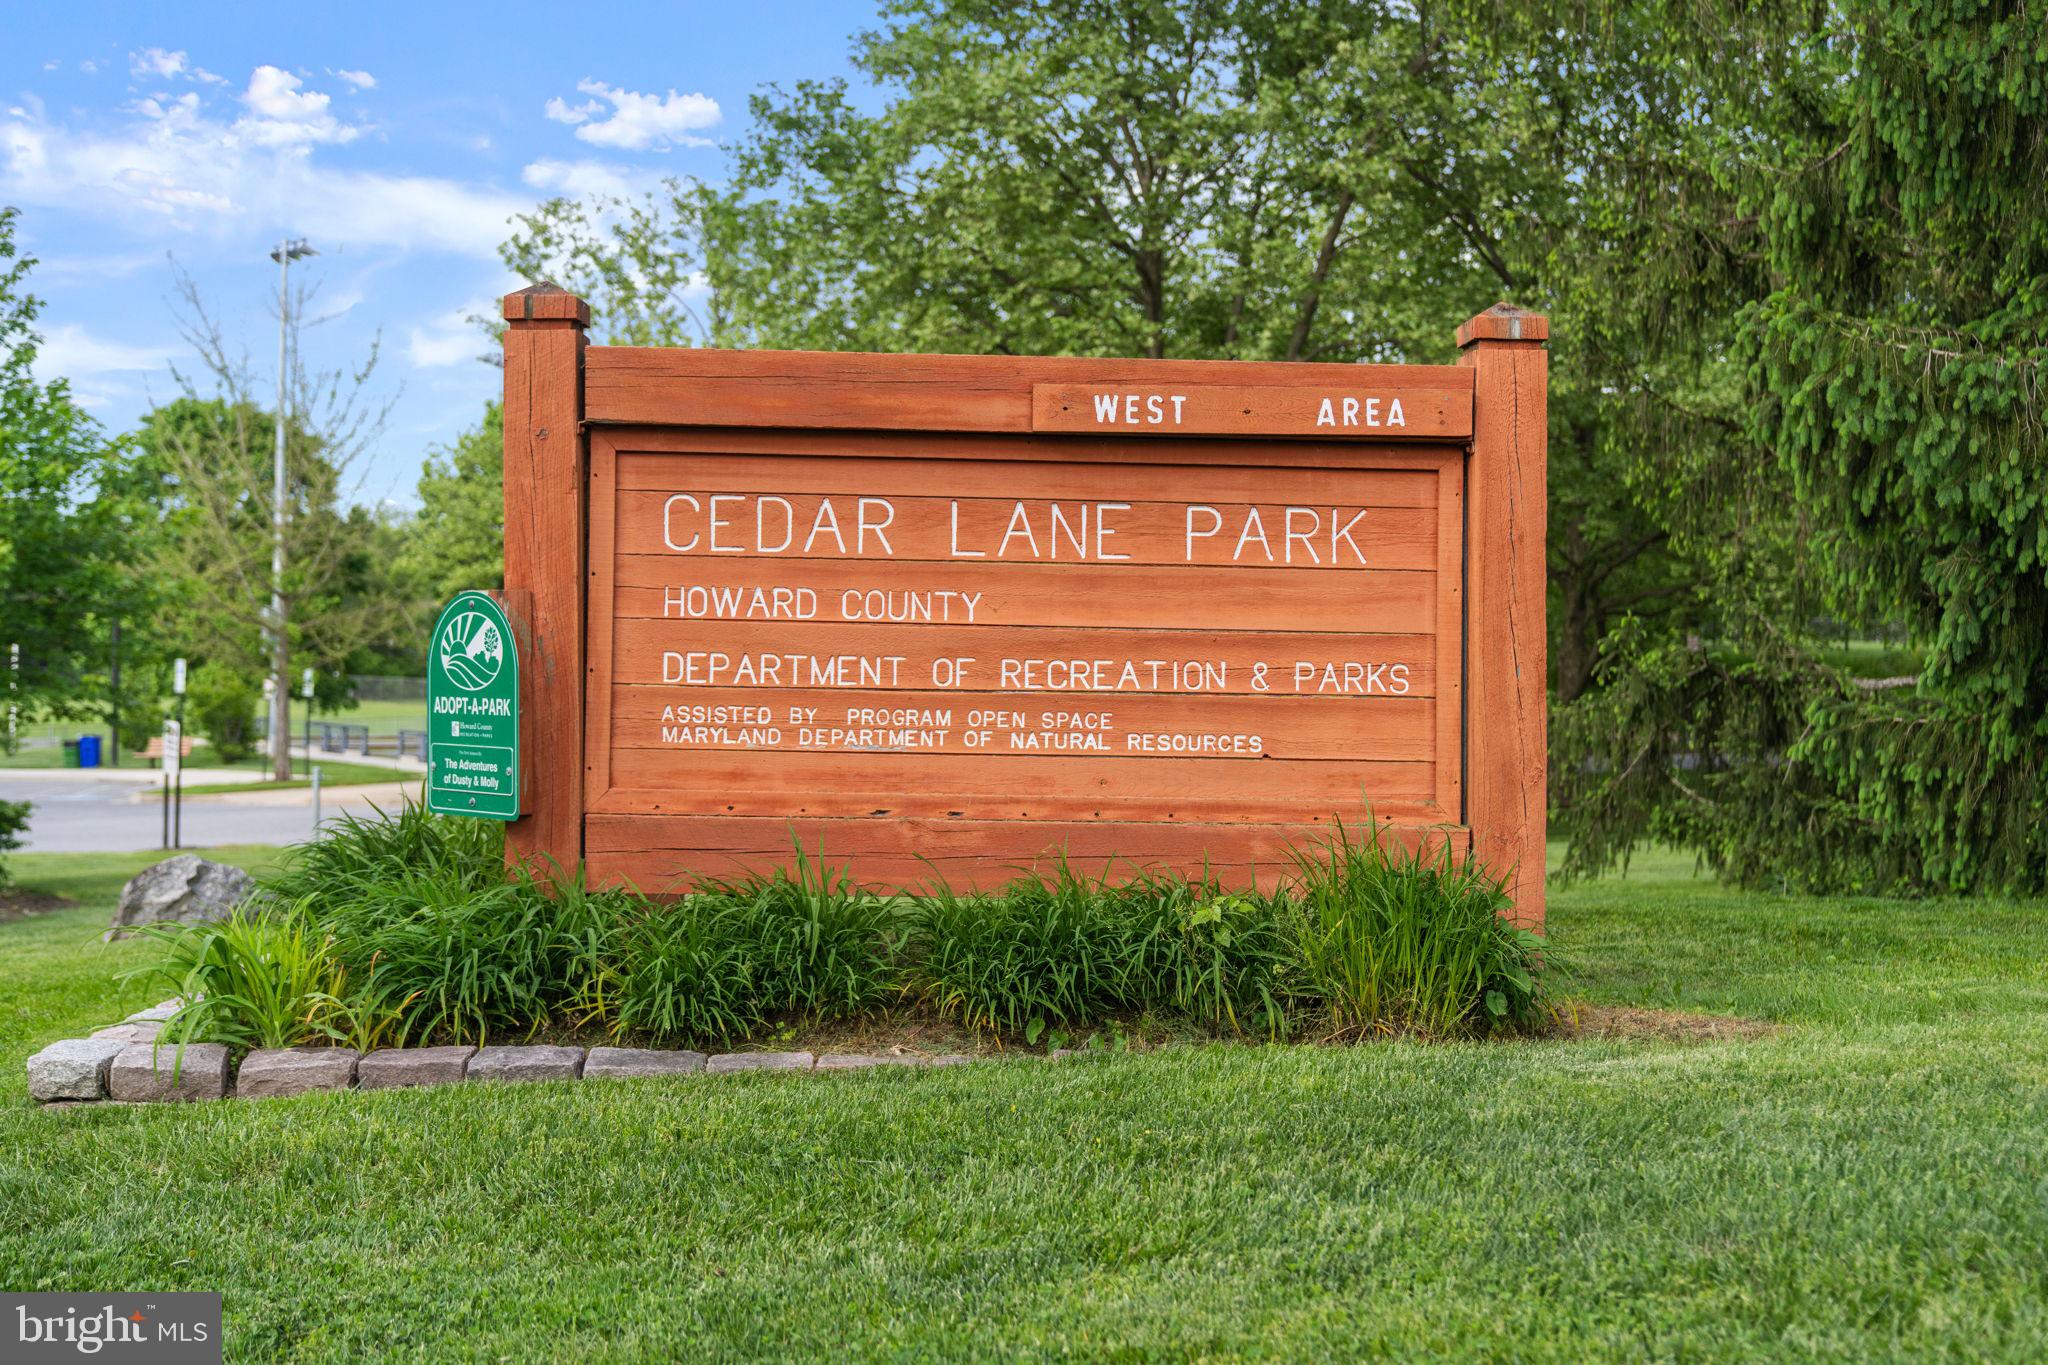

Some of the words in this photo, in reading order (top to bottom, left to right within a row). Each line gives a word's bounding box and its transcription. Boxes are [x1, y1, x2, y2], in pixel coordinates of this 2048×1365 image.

[1094, 394, 1187, 425] WEST
[1317, 397, 1406, 427] AREA
[663, 493, 893, 555] CEDAR
[951, 499, 1132, 560] LANE
[1185, 505, 1368, 565] PARK
[663, 585, 818, 619] HOWARD
[841, 589, 982, 623] COUNTY
[662, 651, 907, 687] DEPARTMENT
[932, 657, 977, 688] OF
[1000, 658, 1227, 691] RECREATION
[1250, 661, 1271, 692] &
[1293, 661, 1411, 695] PARKS
[434, 696, 511, 716] ADOPT-A-PARK
[661, 705, 772, 725] ASSISTED
[789, 707, 818, 725] BY
[847, 708, 952, 727] PROGRAM
[967, 710, 1026, 729] OPEN
[1041, 711, 1114, 731] SPACE
[661, 727, 782, 745] MARYLAND
[799, 729, 948, 748] DEPARTMENT
[963, 731, 994, 748] OF
[1010, 732, 1112, 750] NATURAL
[1127, 734, 1263, 753] RESOURCES
[444, 758, 458, 769] The
[459, 759, 498, 772] Adventures
[444, 774, 452, 784] of
[452, 774, 472, 788] Dusty
[473, 776, 479, 787] &
[480, 776, 499, 791] Molly
